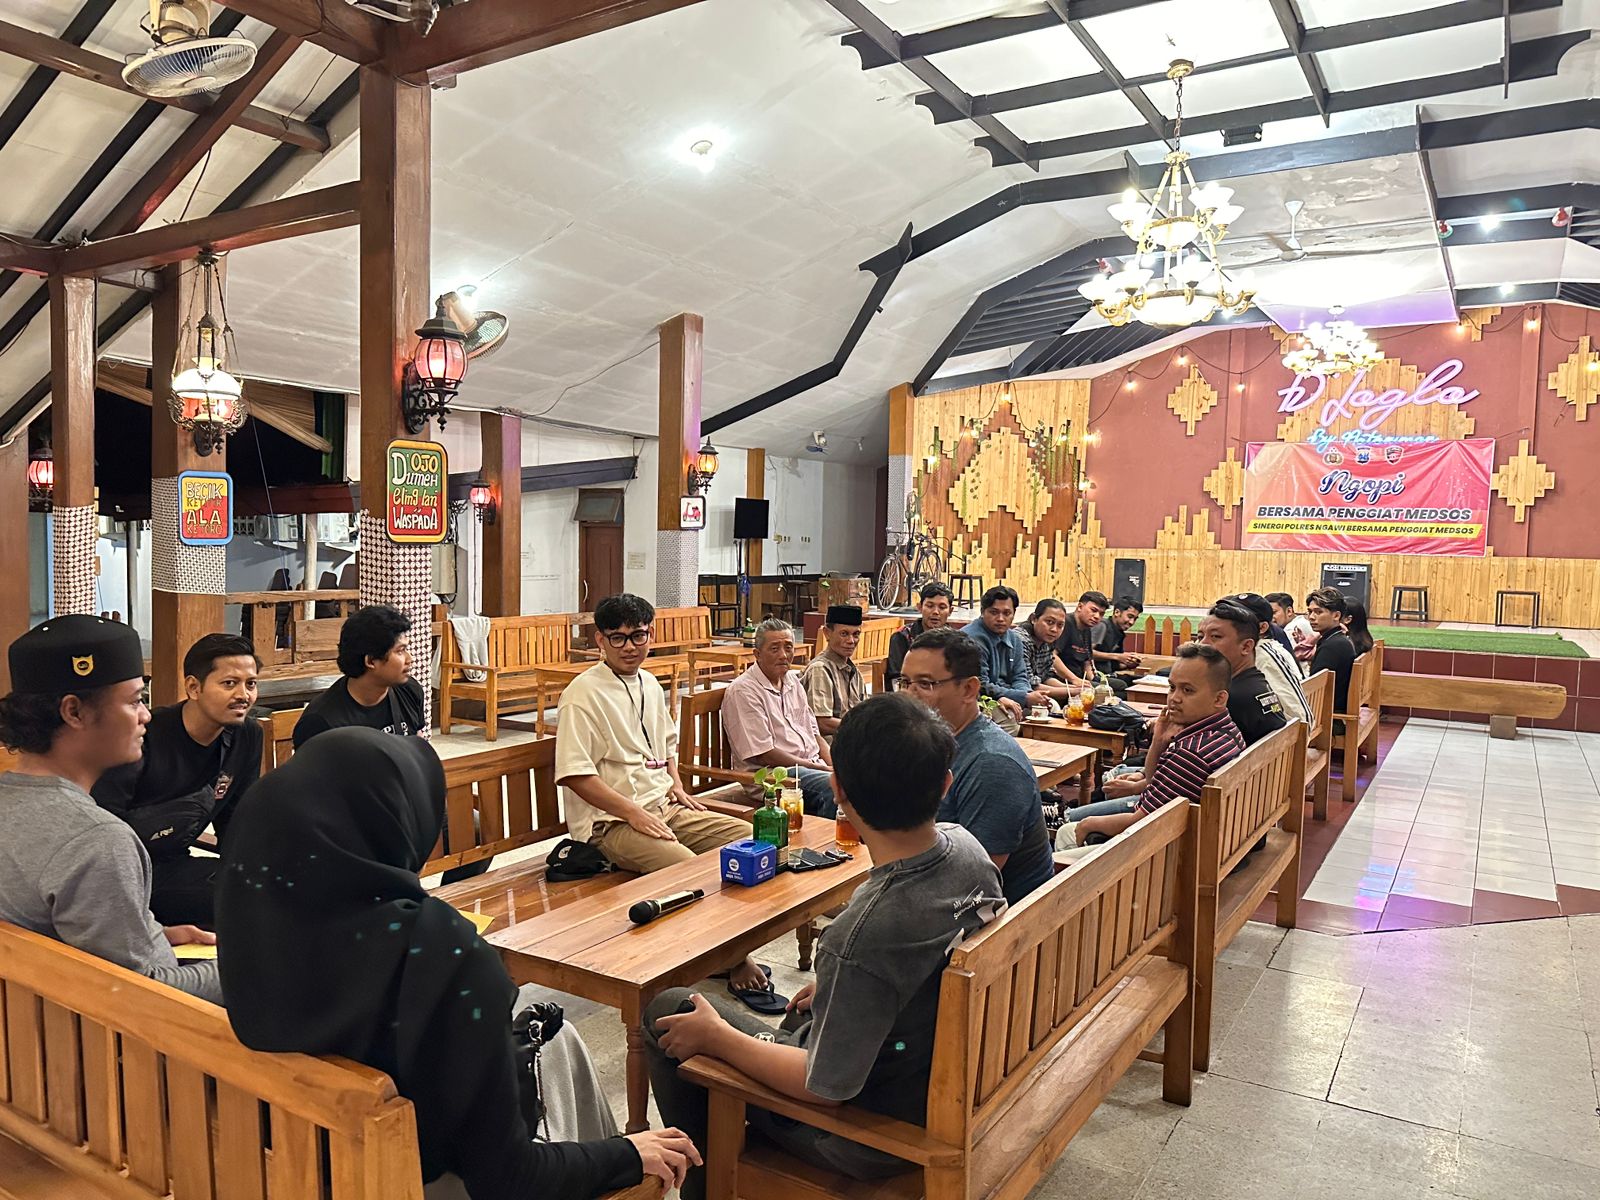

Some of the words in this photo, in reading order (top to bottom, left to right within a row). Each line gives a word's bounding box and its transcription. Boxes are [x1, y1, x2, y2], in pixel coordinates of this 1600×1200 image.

[411, 453, 438, 473] OJO
[186, 481, 224, 500] BECIK
[1319, 470, 1406, 503] Ngopi
[186, 509, 222, 525] ALA
[1257, 506, 1325, 518] BERSAMA
[1327, 507, 1403, 519] PENGGIAT
[1404, 508, 1472, 520] MEDSOS
[1253, 522, 1284, 530] SINERGI
[1285, 523, 1315, 531] POLRES
[1315, 524, 1345, 532] NGAWI
[1346, 525, 1388, 533] BERSAMA
[1389, 526, 1435, 534] PENGGIAT
[1435, 527, 1475, 535] MEDSOS
